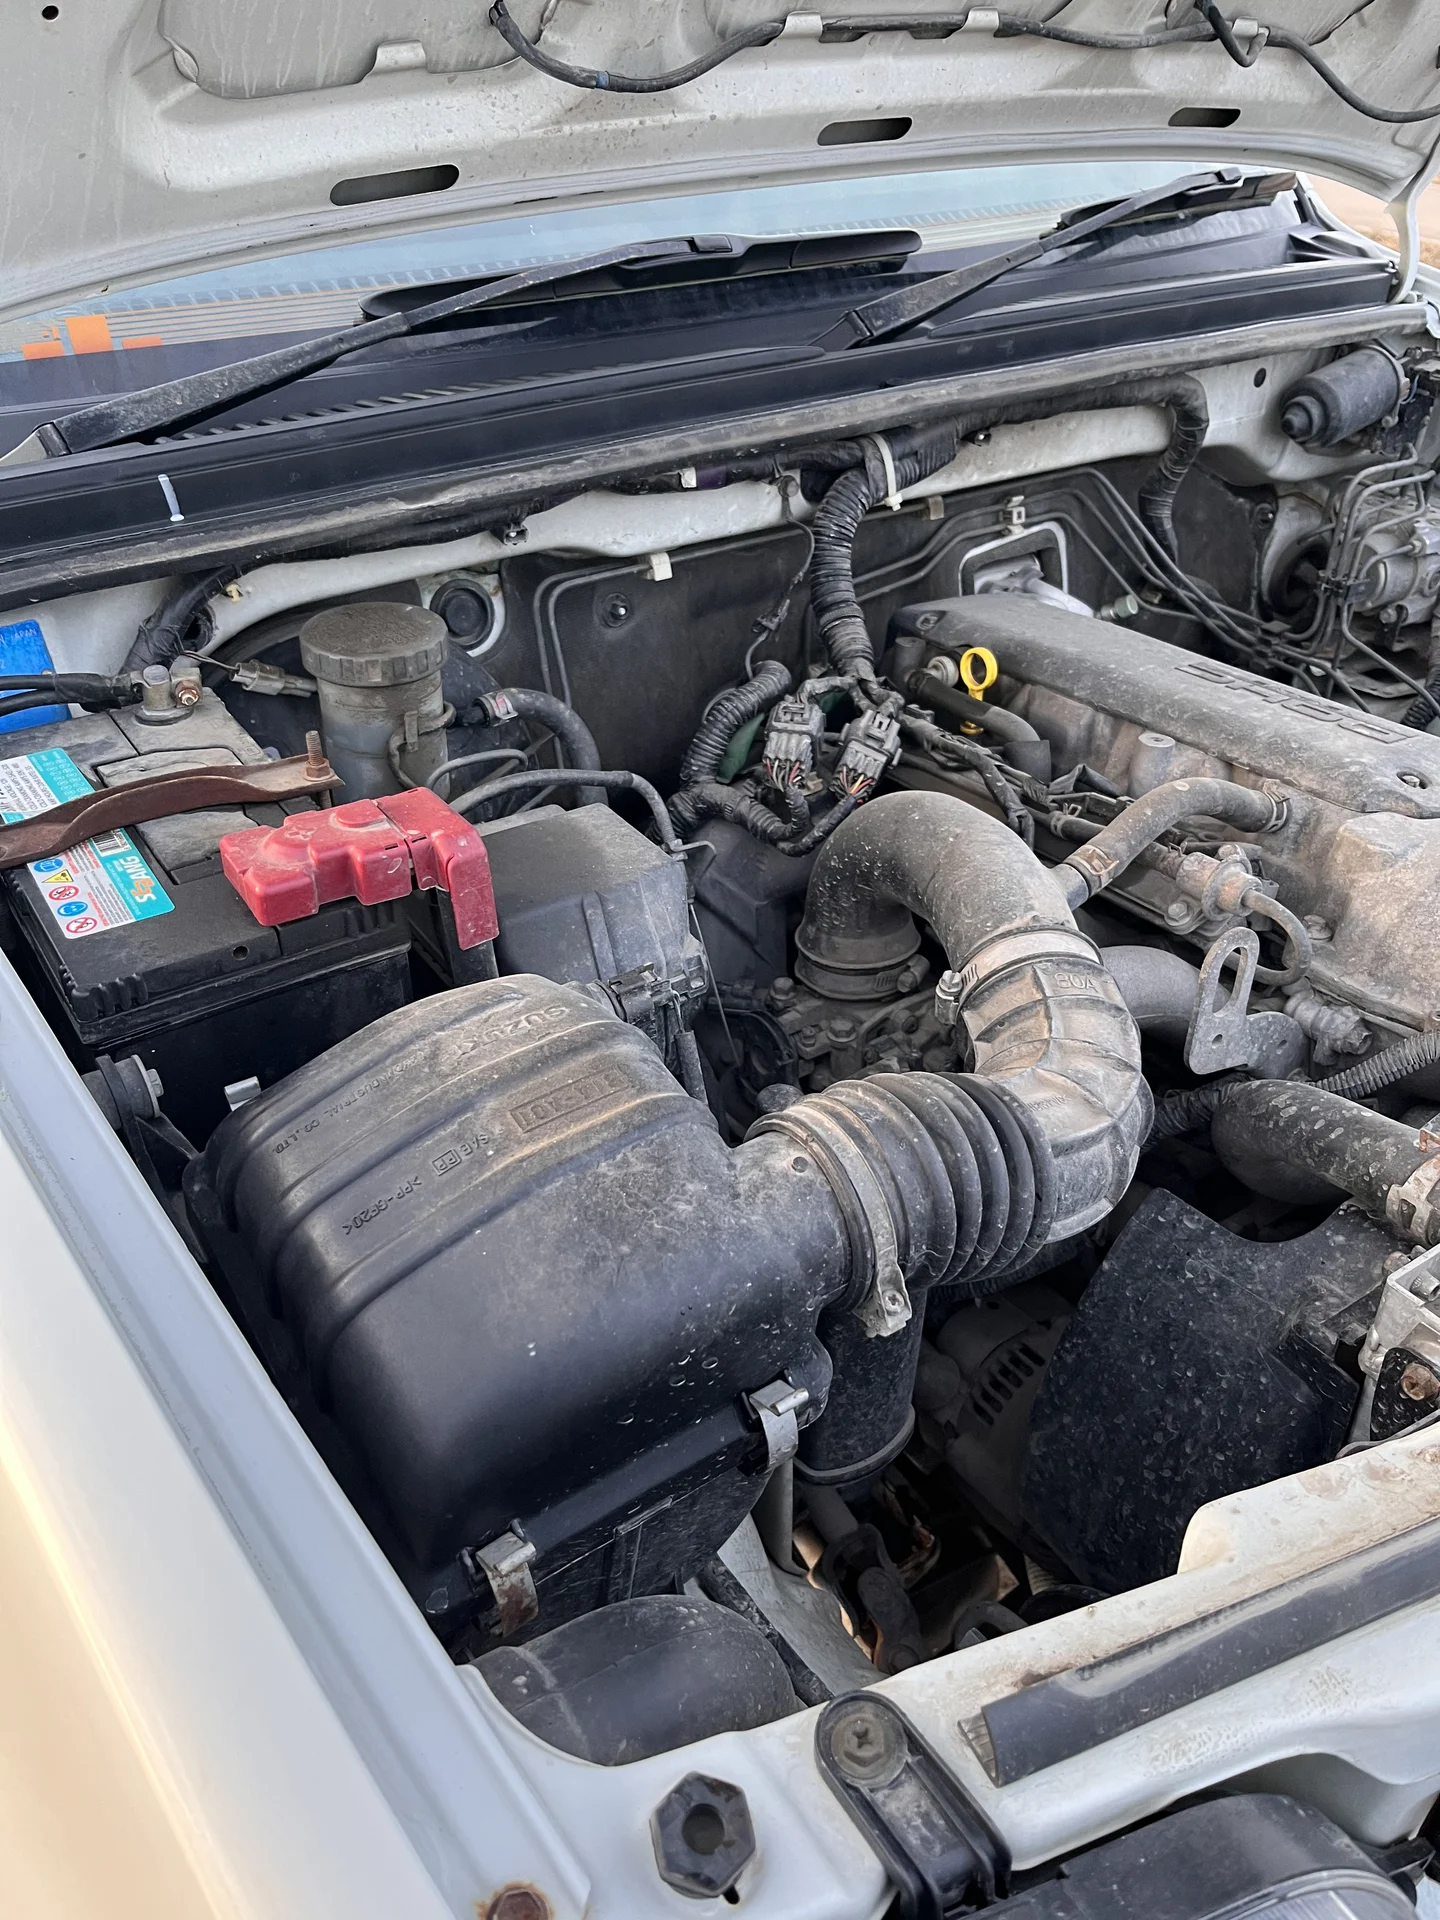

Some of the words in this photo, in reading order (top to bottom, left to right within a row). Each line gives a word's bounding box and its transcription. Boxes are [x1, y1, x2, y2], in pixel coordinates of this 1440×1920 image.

[11, 628, 37, 641] JAPAN
[1054, 972, 1098, 993] 80A
[455, 1004, 569, 1058] SUZUKI
[463, 1132, 490, 1156] SAE
